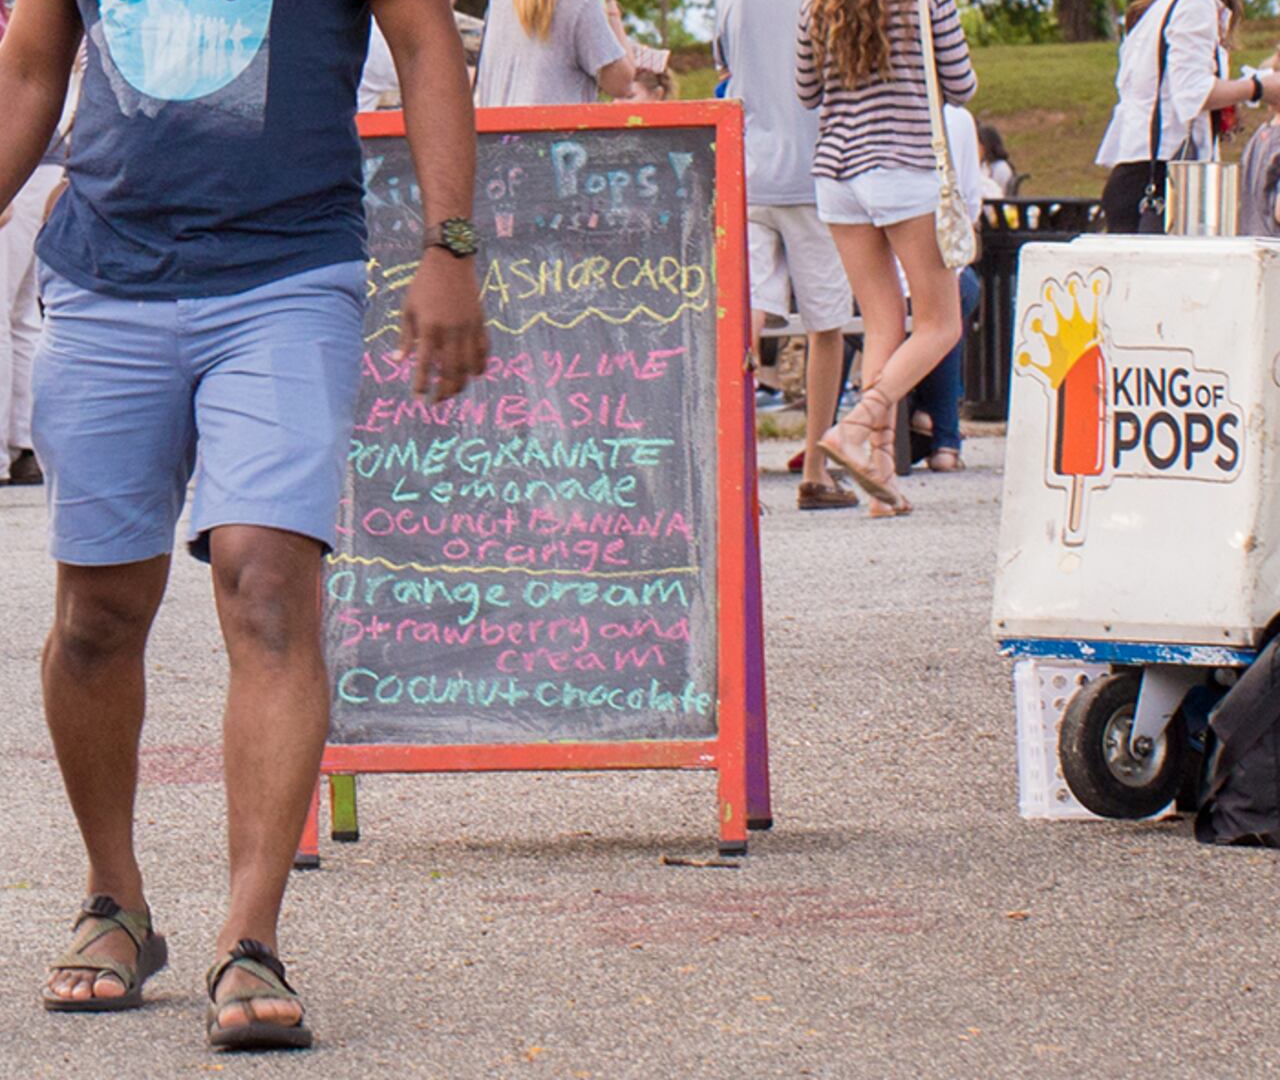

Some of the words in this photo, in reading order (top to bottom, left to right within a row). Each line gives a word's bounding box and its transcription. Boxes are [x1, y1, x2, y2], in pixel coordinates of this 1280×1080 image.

[487, 167, 524, 200] of
[478, 258, 564, 304] ASH
[1112, 367, 1191, 408] KING
[1195, 385, 1224, 408] OF
[1112, 410, 1239, 472] POPS
[339, 608, 590, 652] Strawberry
[599, 616, 691, 643] and
